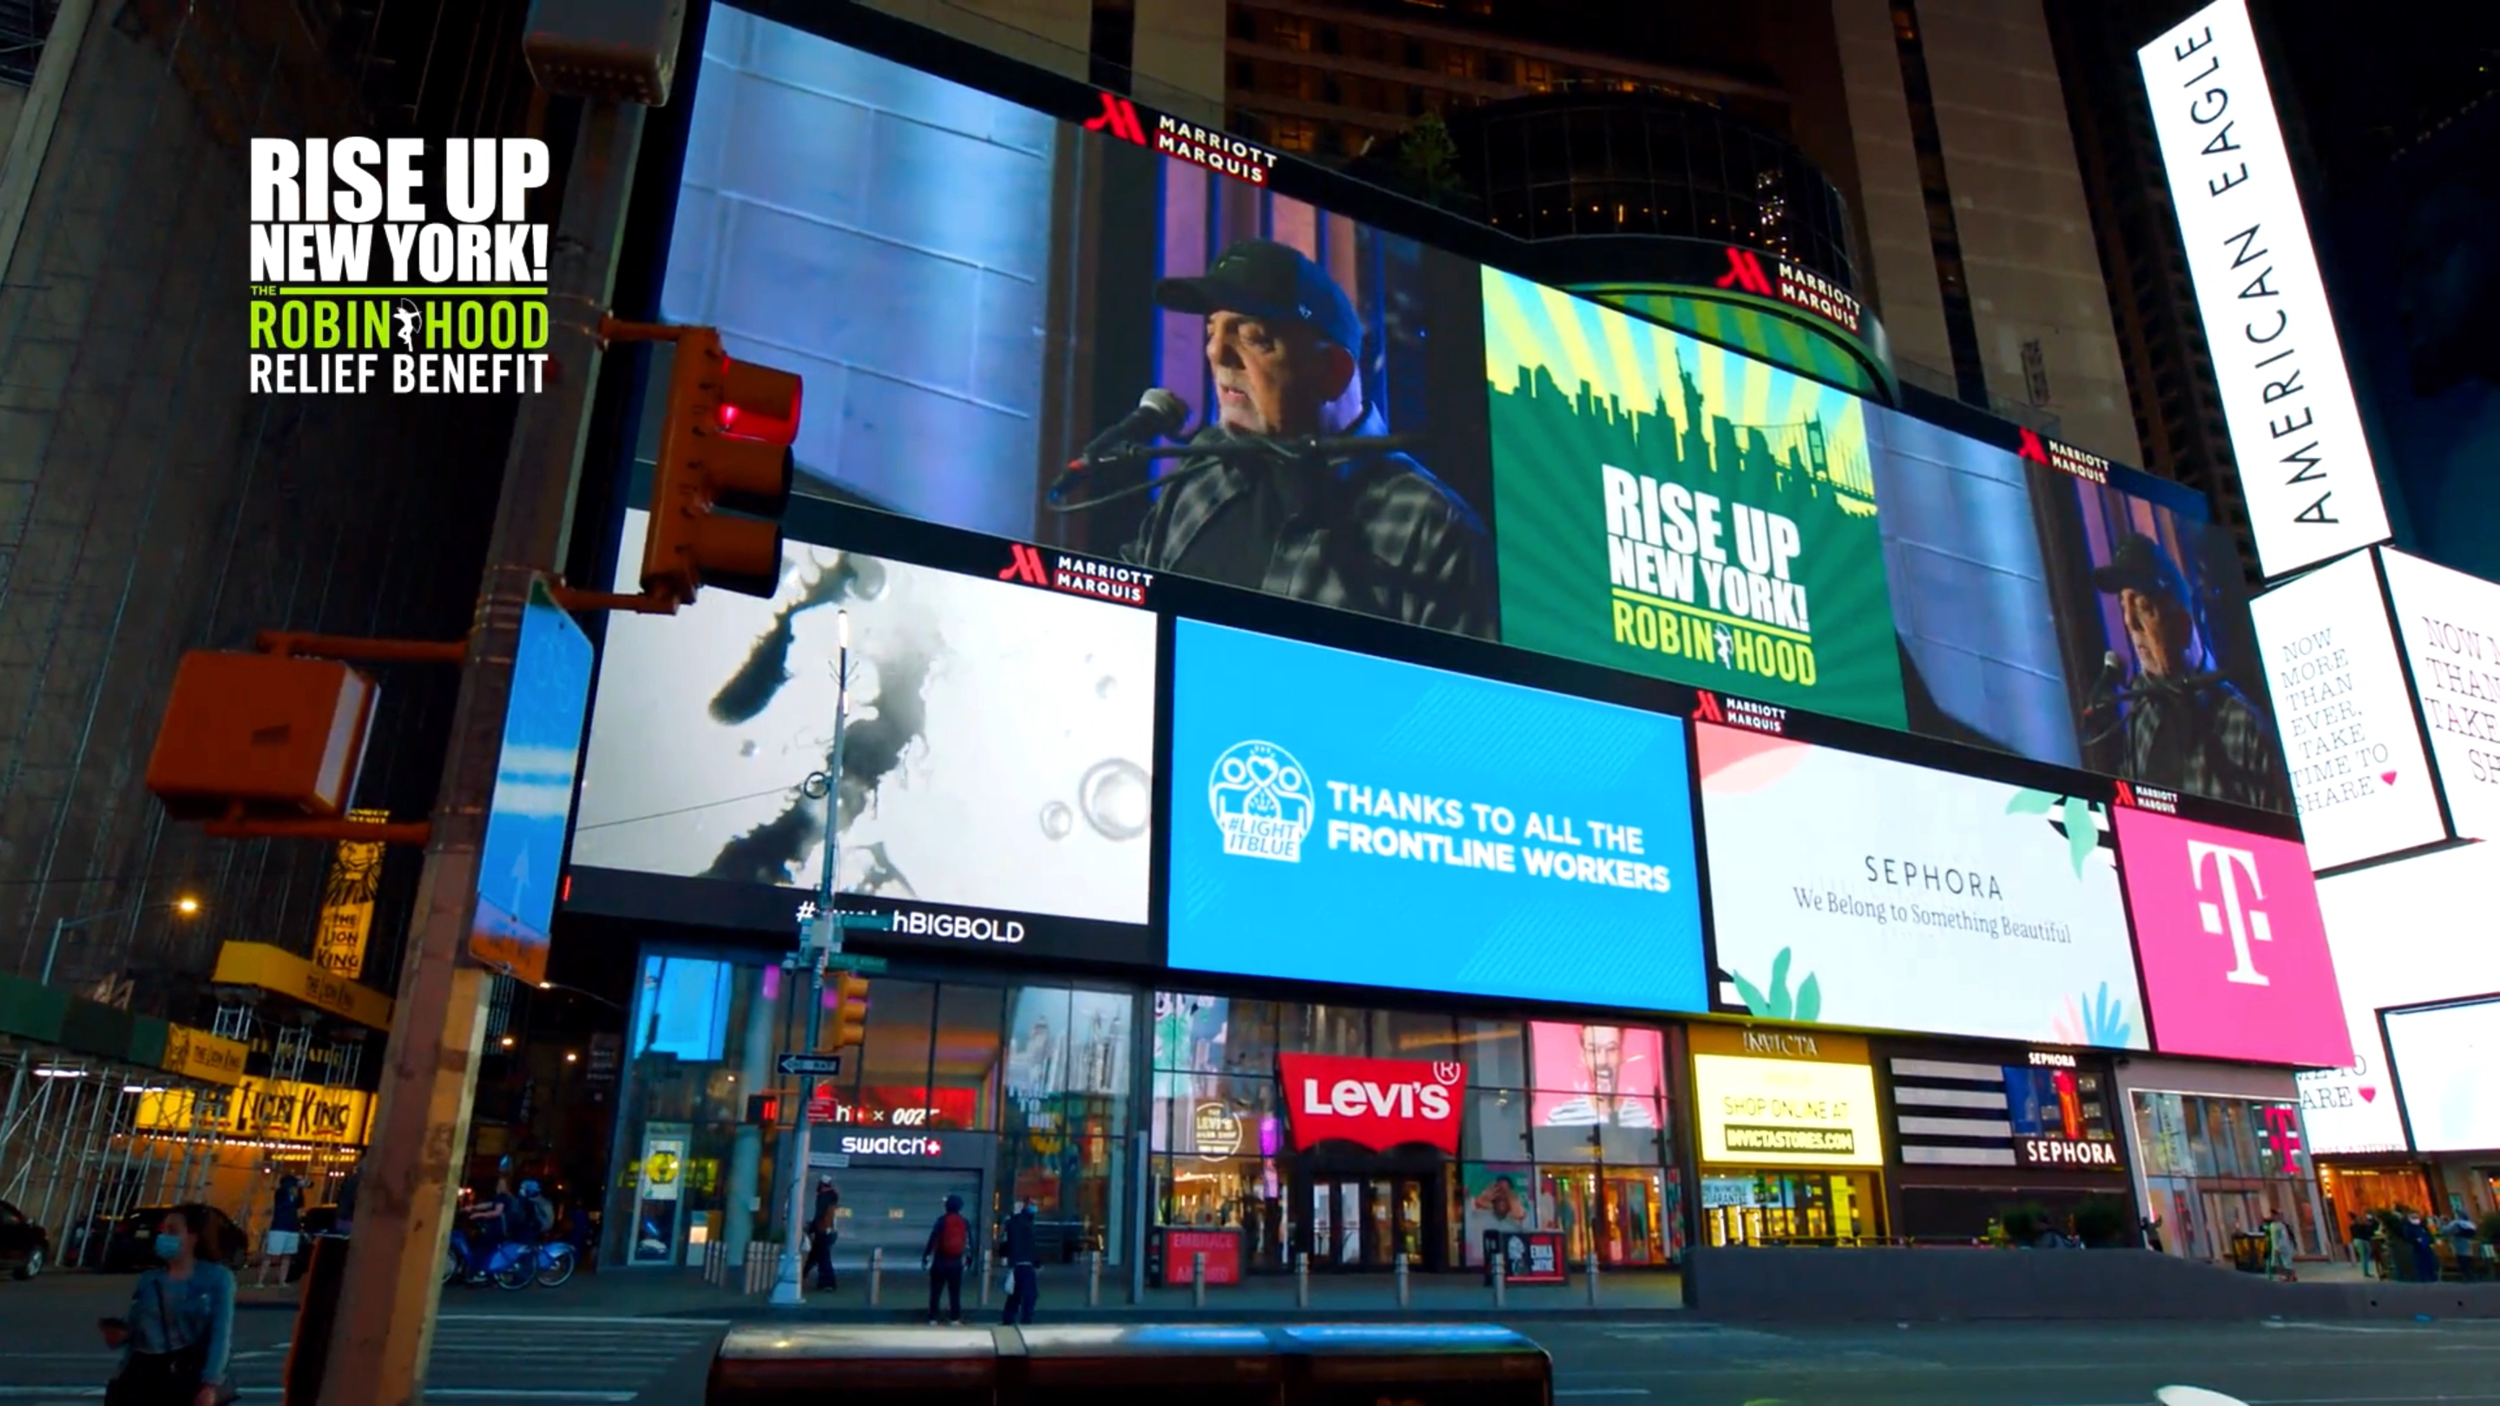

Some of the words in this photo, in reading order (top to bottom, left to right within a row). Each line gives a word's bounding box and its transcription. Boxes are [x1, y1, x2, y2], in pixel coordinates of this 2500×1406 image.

[2174, 26, 2249, 197] EAGLE
[1158, 134, 1264, 183] MARQUIS
[1159, 114, 1278, 168] MARRIOTT
[1778, 262, 1861, 316] MARRIOTT
[1781, 283, 1858, 331] MARQUIS
[2223, 223, 2340, 525] AMERICAN
[2048, 439, 2109, 472] MARRIOTT
[2052, 455, 2107, 484] MARQUIS
[1602, 463, 1728, 564] RISE
[1732, 502, 1801, 581] UP
[1057, 573, 1142, 602] MARQUIS
[1058, 556, 1154, 587] MARRIOTT
[1607, 533, 1695, 603] NEW
[1698, 558, 1810, 632] YORK!
[1612, 598, 1716, 664] ROBIN
[1733, 628, 1817, 686] HOOD
[2281, 627, 2333, 663] NOW
[2421, 615, 2483, 661] NOW
[2280, 648, 2350, 689] MORE
[1726, 698, 1787, 720] MARRIOTT
[2285, 673, 2354, 712] THAN
[1728, 711, 1782, 733] MARQUIS
[2298, 722, 2366, 760] TAKE
[2289, 755, 2352, 789] TIME
[2355, 743, 2389, 768] TO
[2135, 785, 2178, 803] MARRIOTT
[2137, 797, 2177, 815] MARQUIS
[2294, 775, 2375, 816] SHARE
[1228, 816, 1297, 841] #LIGHT
[1326, 780, 1465, 828] THANKS
[1471, 803, 1516, 836] TO
[1524, 812, 1581, 846] ALL
[1587, 820, 1645, 855] THE
[1229, 832, 1296, 857] ITBLUE
[1327, 819, 1516, 873] FRONTLINE
[1521, 846, 1671, 893] WORKERS
[1864, 854, 2004, 902] SEPHORA
[795, 900, 1025, 944] #hBIGBOLD
[1792, 886, 1823, 911] We
[1826, 890, 1888, 925] Belong
[1890, 904, 1908, 924] to
[1911, 903, 2000, 940] Something
[2001, 915, 2073, 945] Beautiful
[1743, 1031, 1819, 1057] INVICTA
[2028, 1051, 2076, 1067] SEPHORA
[1724, 1096, 1767, 1116] SHOP
[1770, 1099, 1828, 1119] ONLINE
[1831, 1102, 1848, 1118] AT
[842, 1134, 927, 1155] swatch
[1727, 1129, 1853, 1150] INVICTASTORES.COM
[2027, 1140, 2117, 1164] SEPHORA
